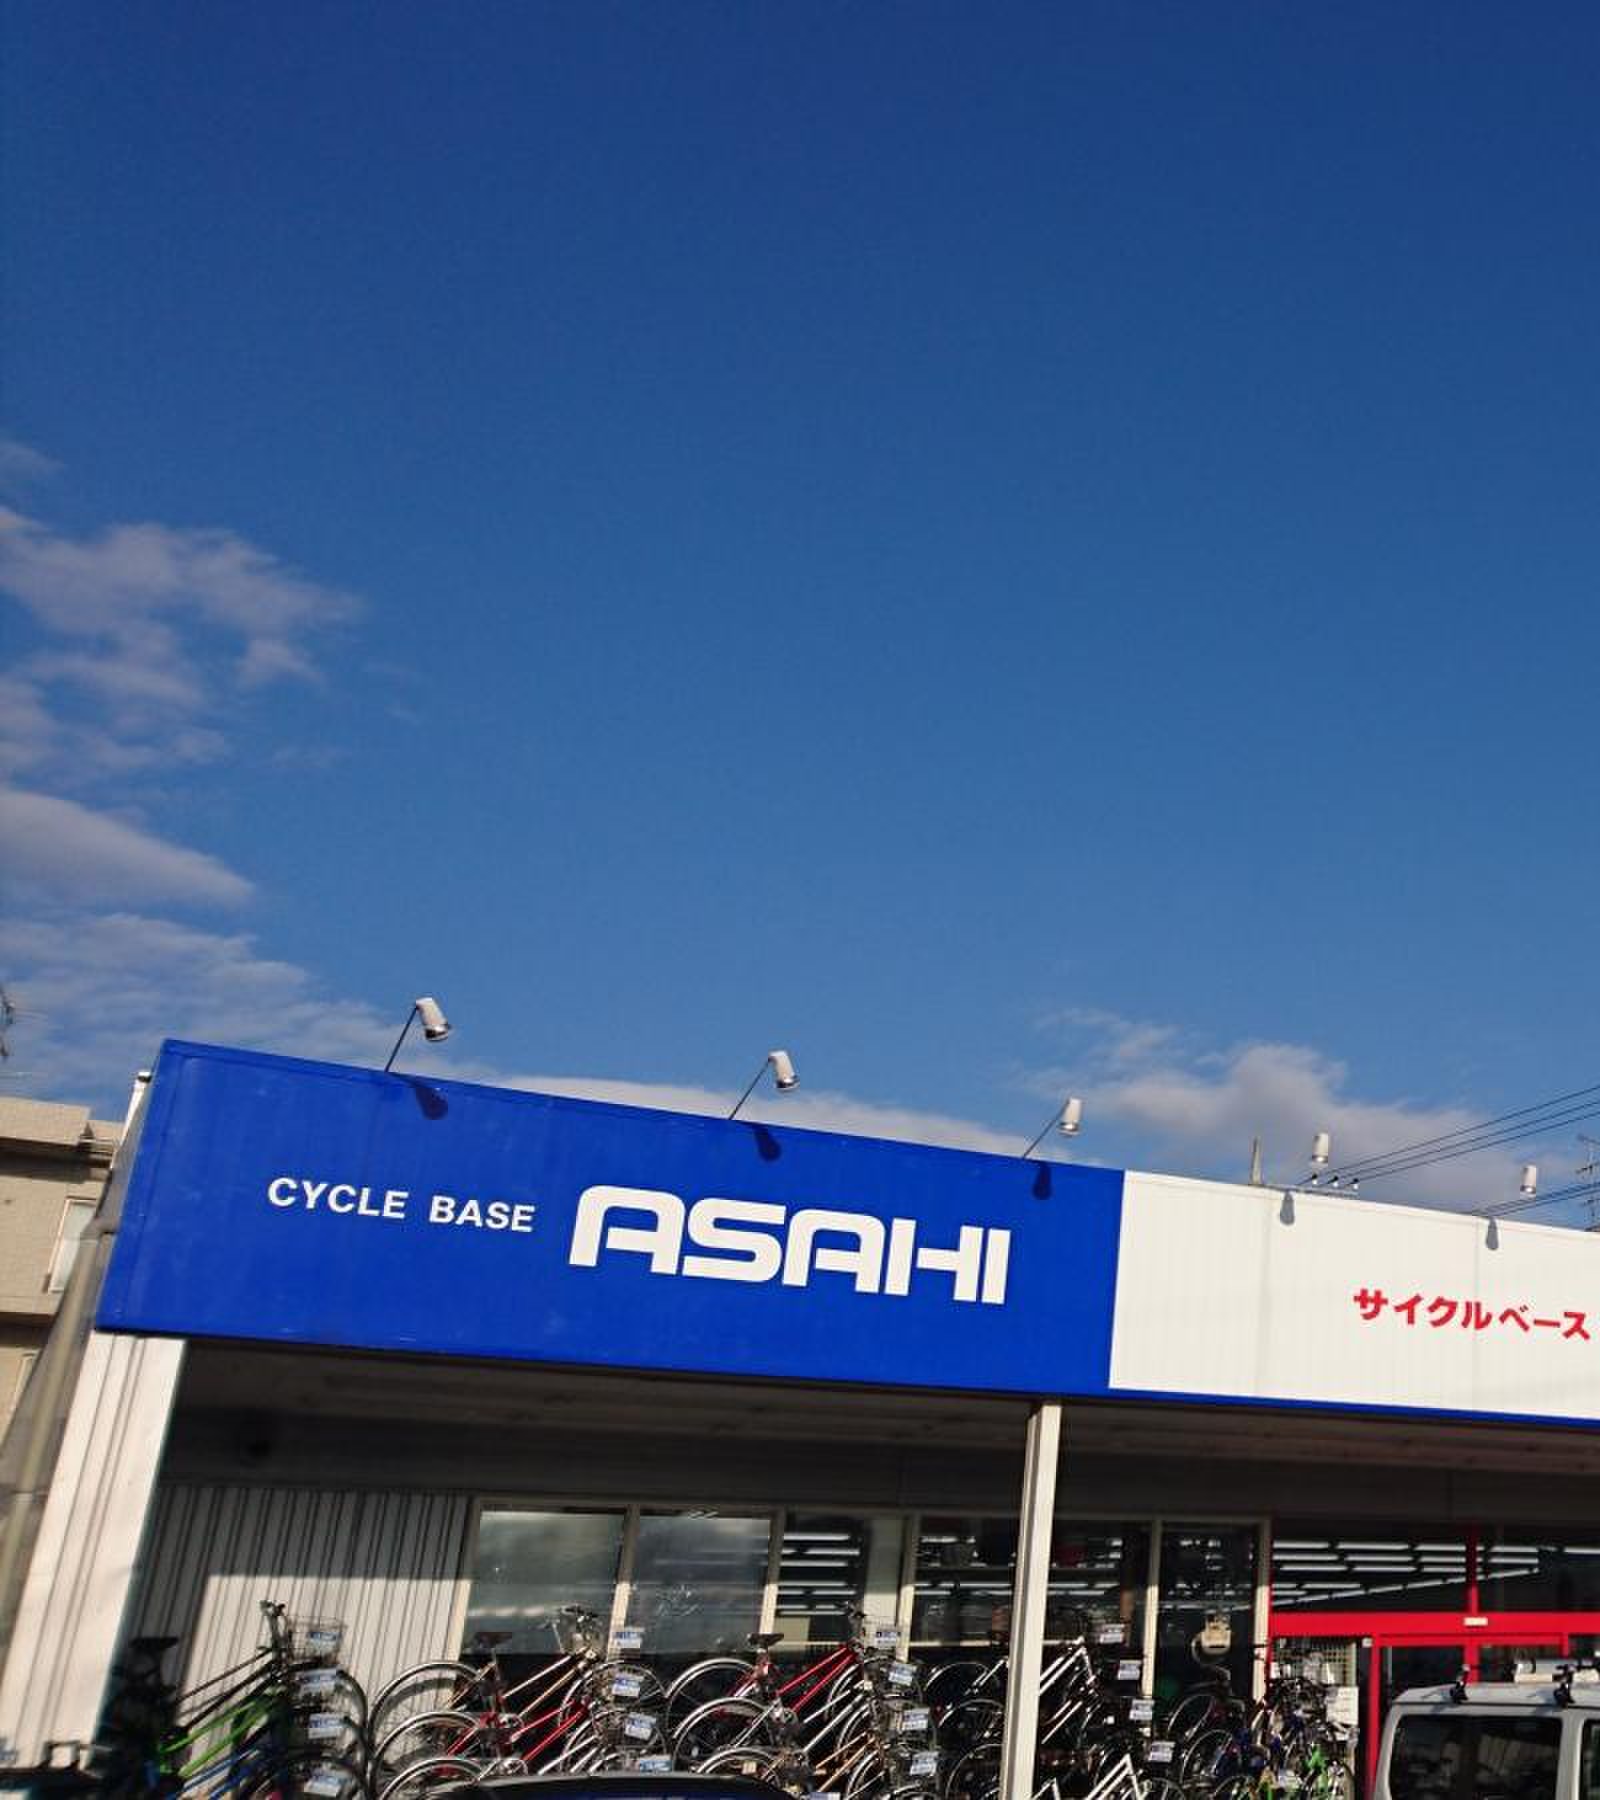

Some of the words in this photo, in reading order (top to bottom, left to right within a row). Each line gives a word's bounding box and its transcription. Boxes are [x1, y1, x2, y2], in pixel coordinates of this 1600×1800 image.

[267, 1177, 409, 1219] CYCLE
[428, 1195, 536, 1233] BASE
[568, 1185, 1011, 1305] ASAHI
[1353, 1288, 1591, 1340] サイクルベース
